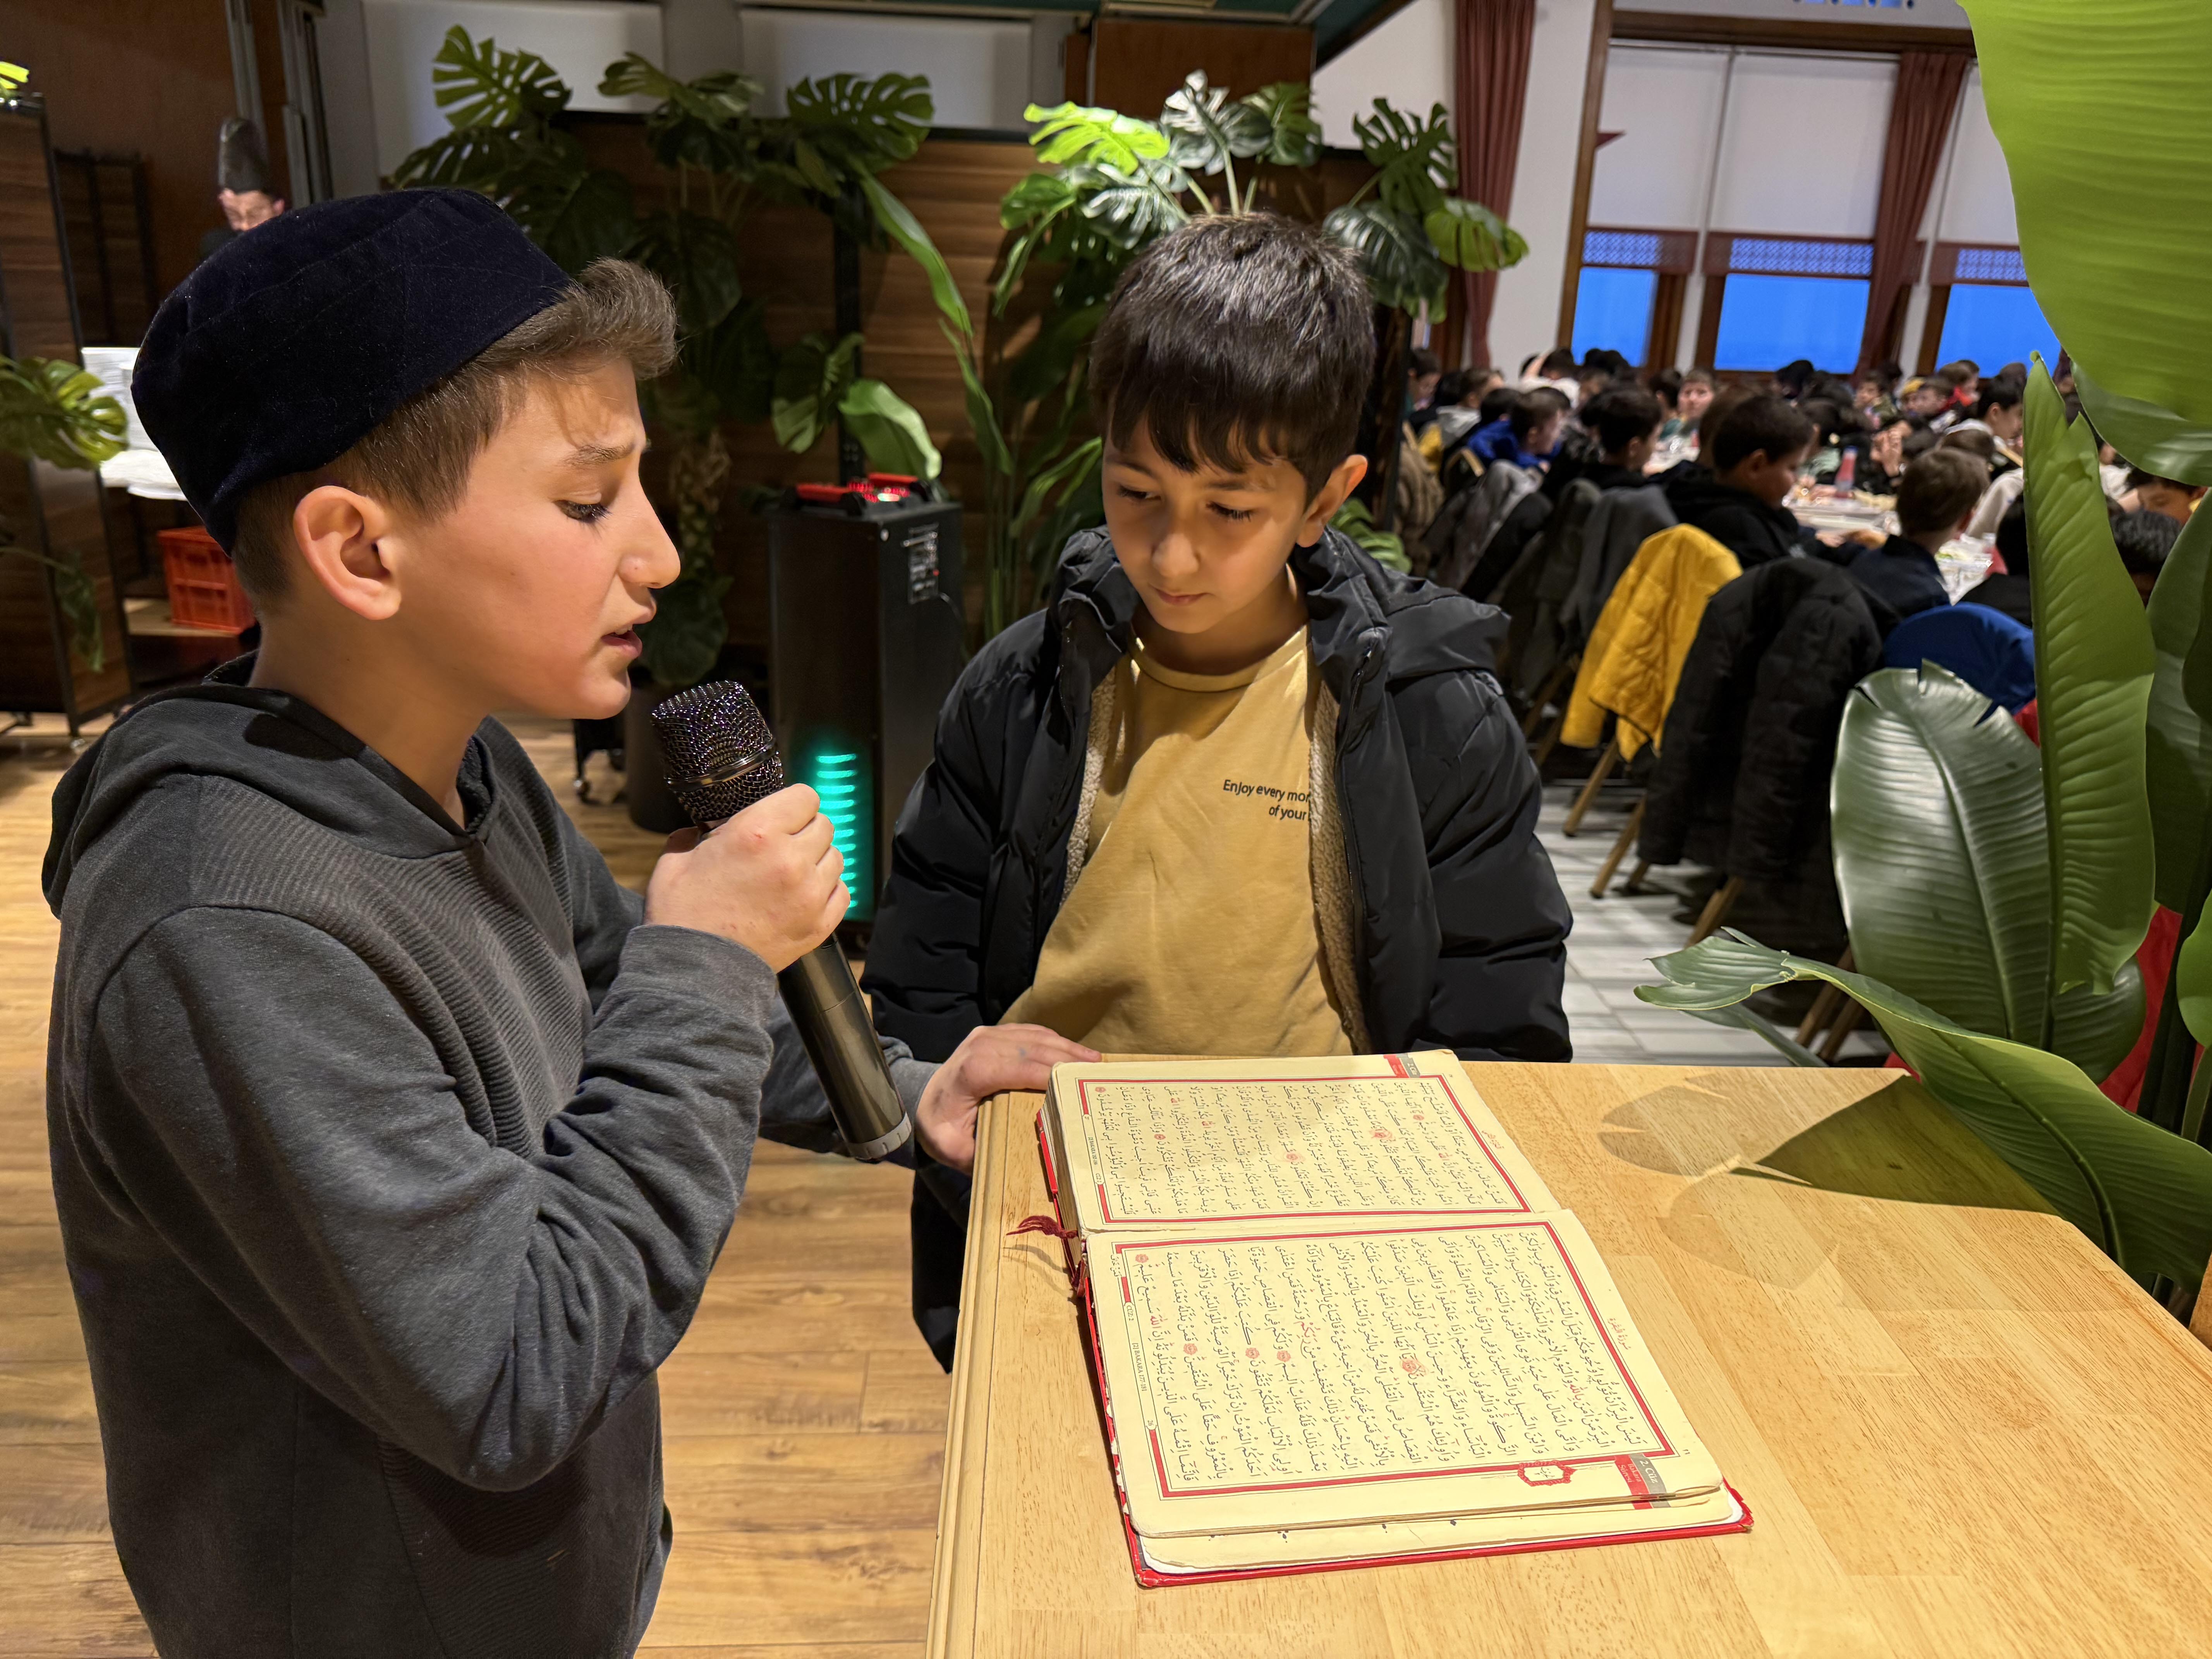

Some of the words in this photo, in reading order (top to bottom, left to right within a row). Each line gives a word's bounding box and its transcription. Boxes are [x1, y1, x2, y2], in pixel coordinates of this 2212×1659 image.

[1223, 780, 1255, 797] Enjoy
[1256, 786, 1285, 802] every
[1269, 805, 1279, 816] of
[1279, 808, 1307, 821] your
[1134, 1350, 1143, 1373] BAKARA
[1139, 1374, 1147, 1391] 177-181
[1628, 1463, 1641, 1482] Bakara
[1645, 1467, 1658, 1484] Cüz
